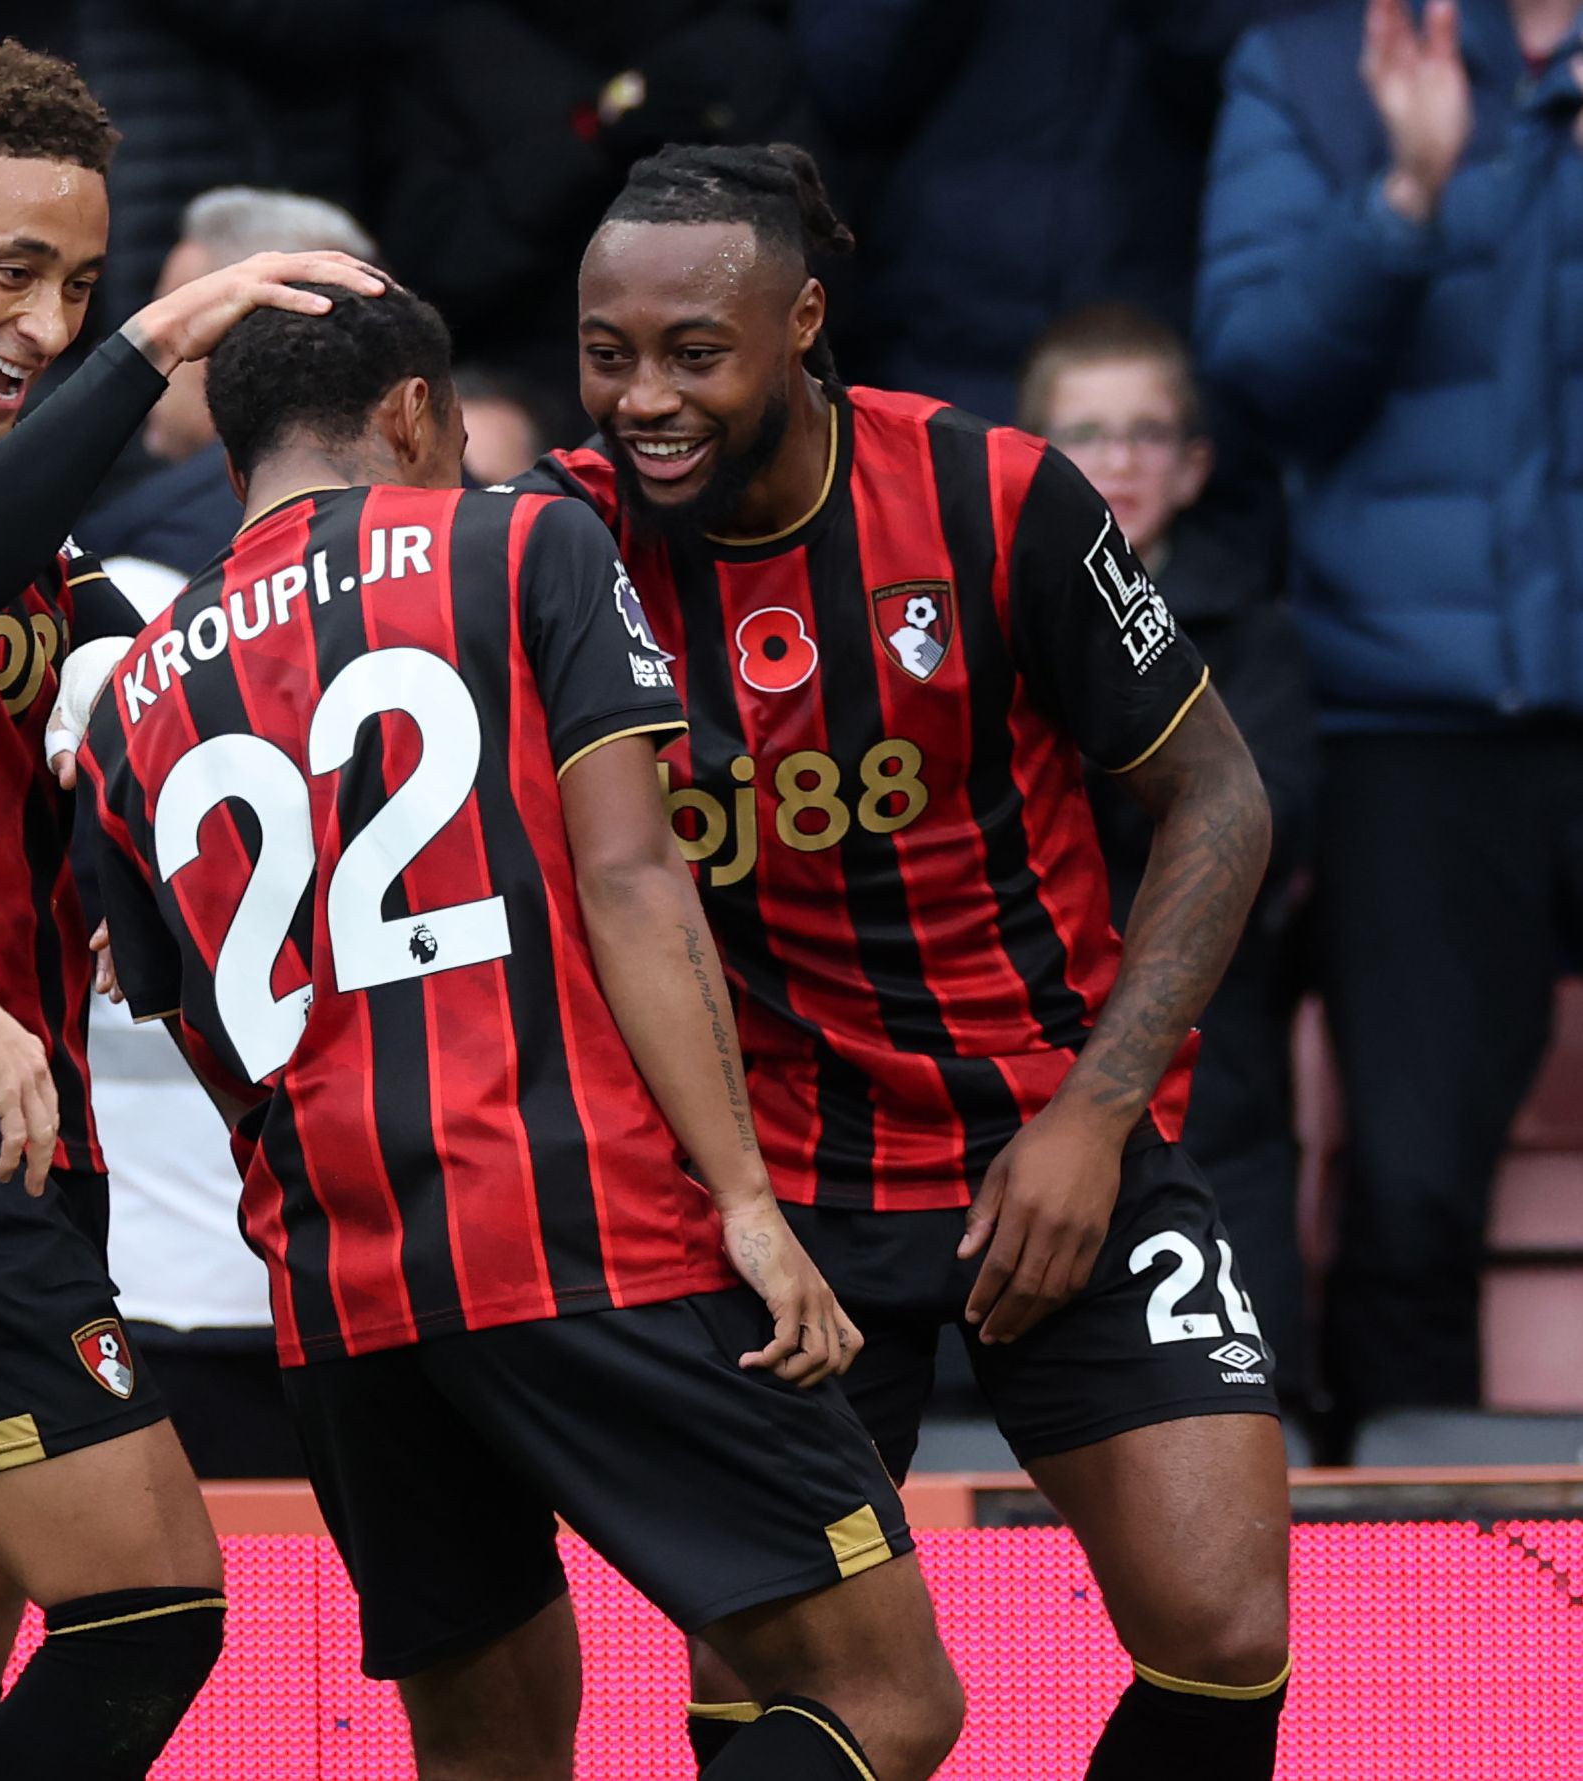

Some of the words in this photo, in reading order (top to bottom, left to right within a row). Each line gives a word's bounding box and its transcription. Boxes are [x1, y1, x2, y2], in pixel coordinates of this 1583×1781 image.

[123, 524, 433, 724] KROUPI.JR
[628, 652, 655, 674] No
[154, 646, 513, 1084] 22
[656, 738, 928, 887] bj88
